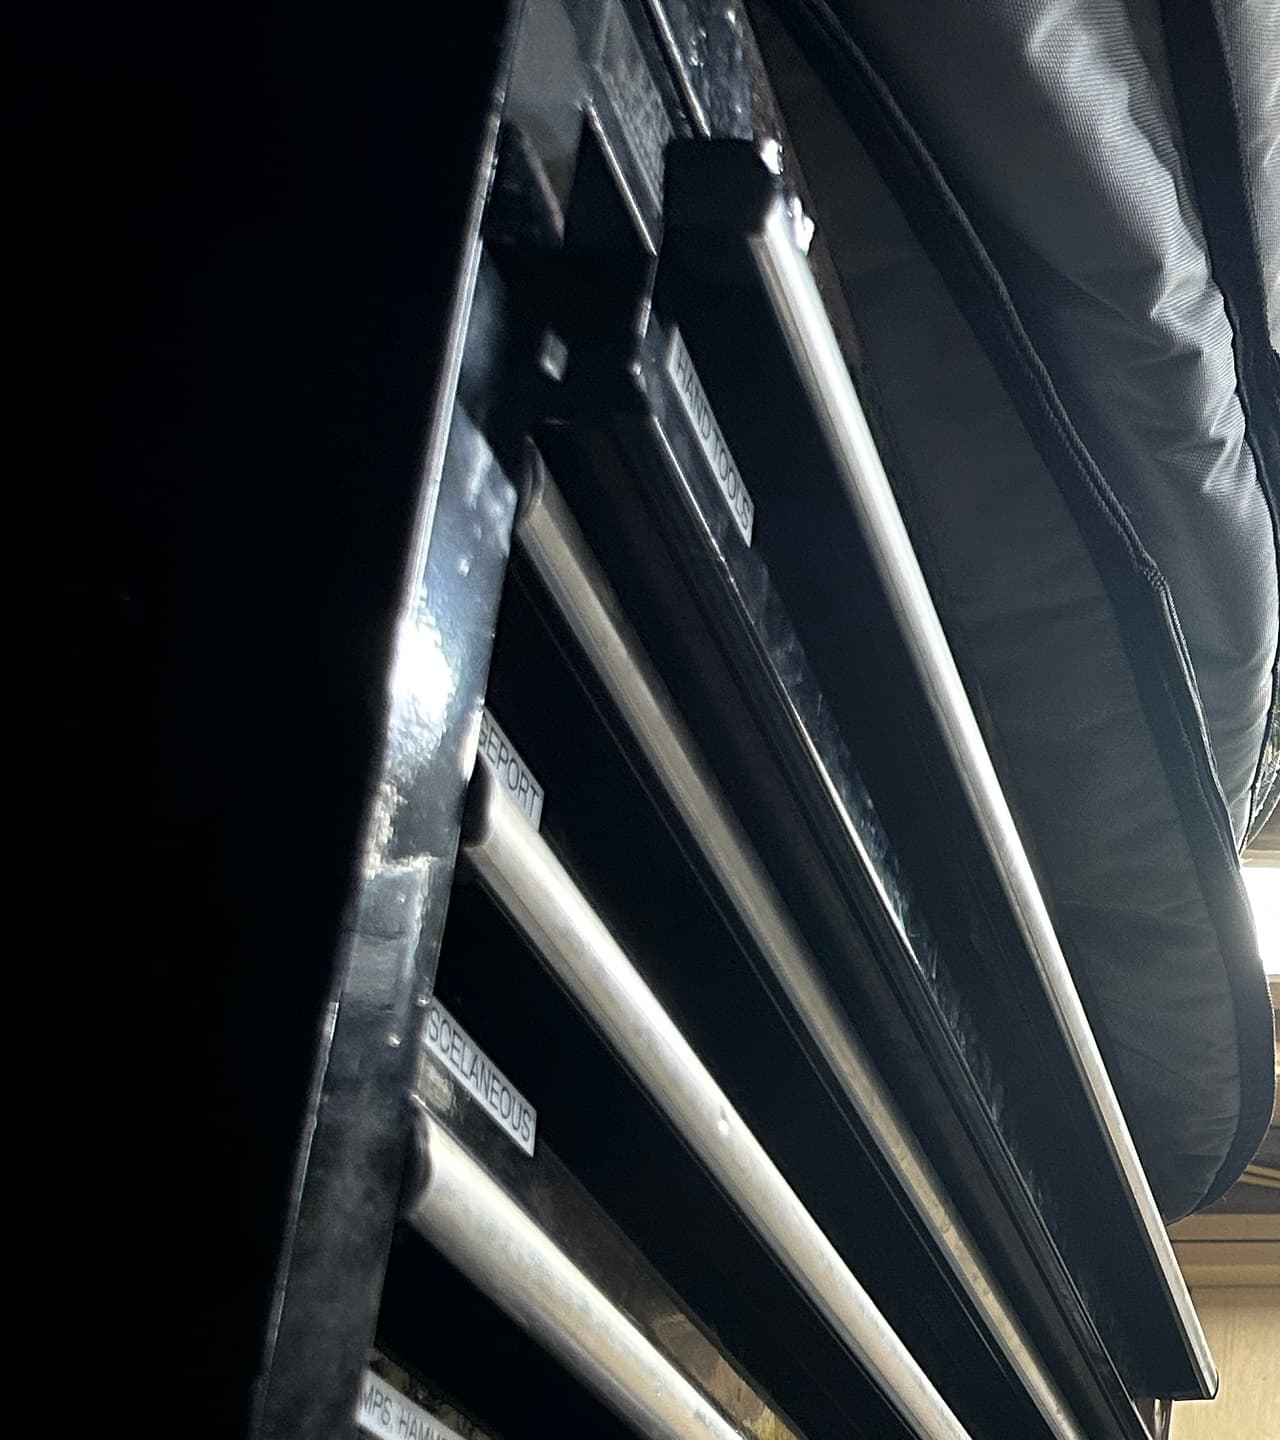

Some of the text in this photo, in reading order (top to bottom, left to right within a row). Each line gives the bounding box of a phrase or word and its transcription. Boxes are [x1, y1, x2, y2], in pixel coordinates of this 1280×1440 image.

[677, 349, 750, 531] HAND TOOLS
[429, 1007, 533, 1142] SCELANEOUS
